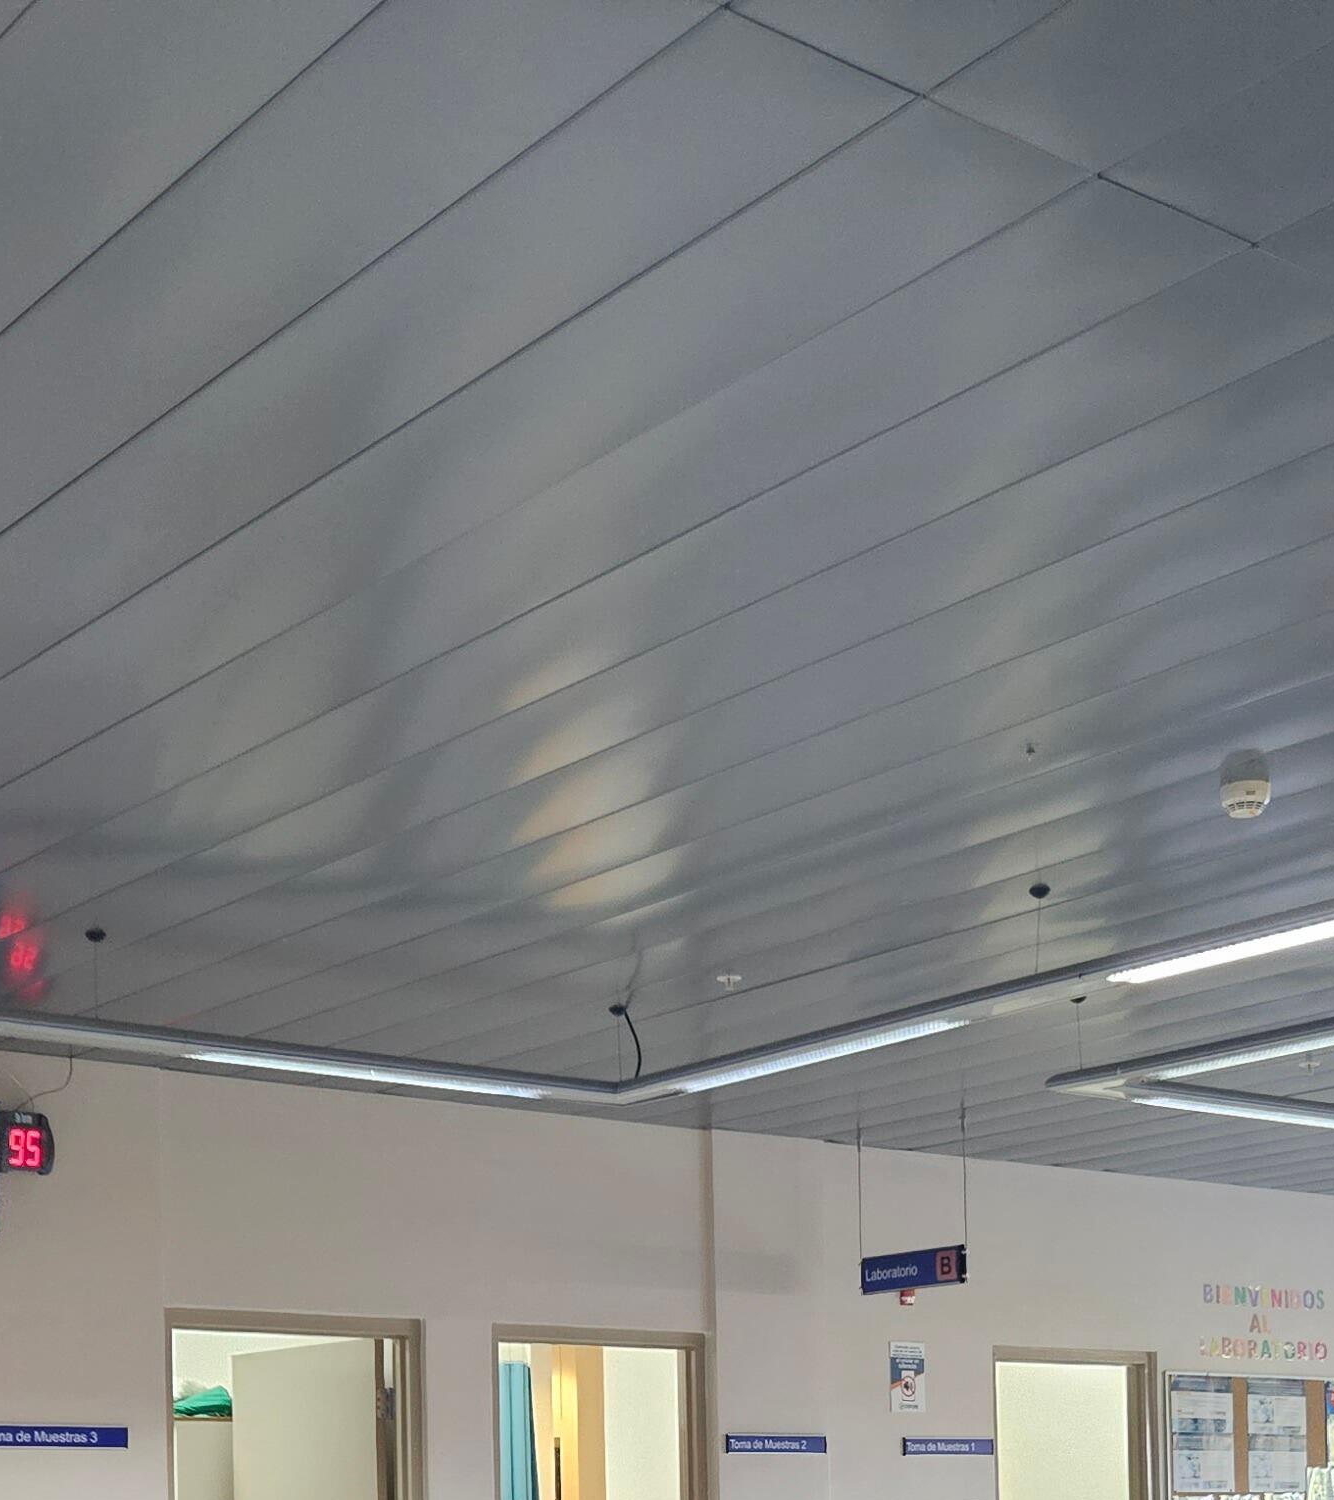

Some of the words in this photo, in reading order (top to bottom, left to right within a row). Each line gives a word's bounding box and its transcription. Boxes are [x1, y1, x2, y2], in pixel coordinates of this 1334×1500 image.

[9, 1128, 41, 1167] 95
[865, 1264, 918, 1282] Laboratorio
[940, 1256, 952, 1275] B
[1203, 1284, 1325, 1310] BIENVENIDOS
[1249, 1314, 1272, 1334] AL
[1199, 1336, 1328, 1360] LABORATORIO
[16, 1430, 31, 1442] de
[34, 1430, 88, 1443] Muestras
[89, 1431, 98, 1443] 3
[729, 1438, 751, 1449] Toma
[752, 1438, 763, 1449] de
[764, 1439, 800, 1449] Muestras
[801, 1440, 807, 1449] 2
[906, 1441, 926, 1452] Toma
[927, 1442, 936, 1452] de
[937, 1442, 969, 1452] Muestras
